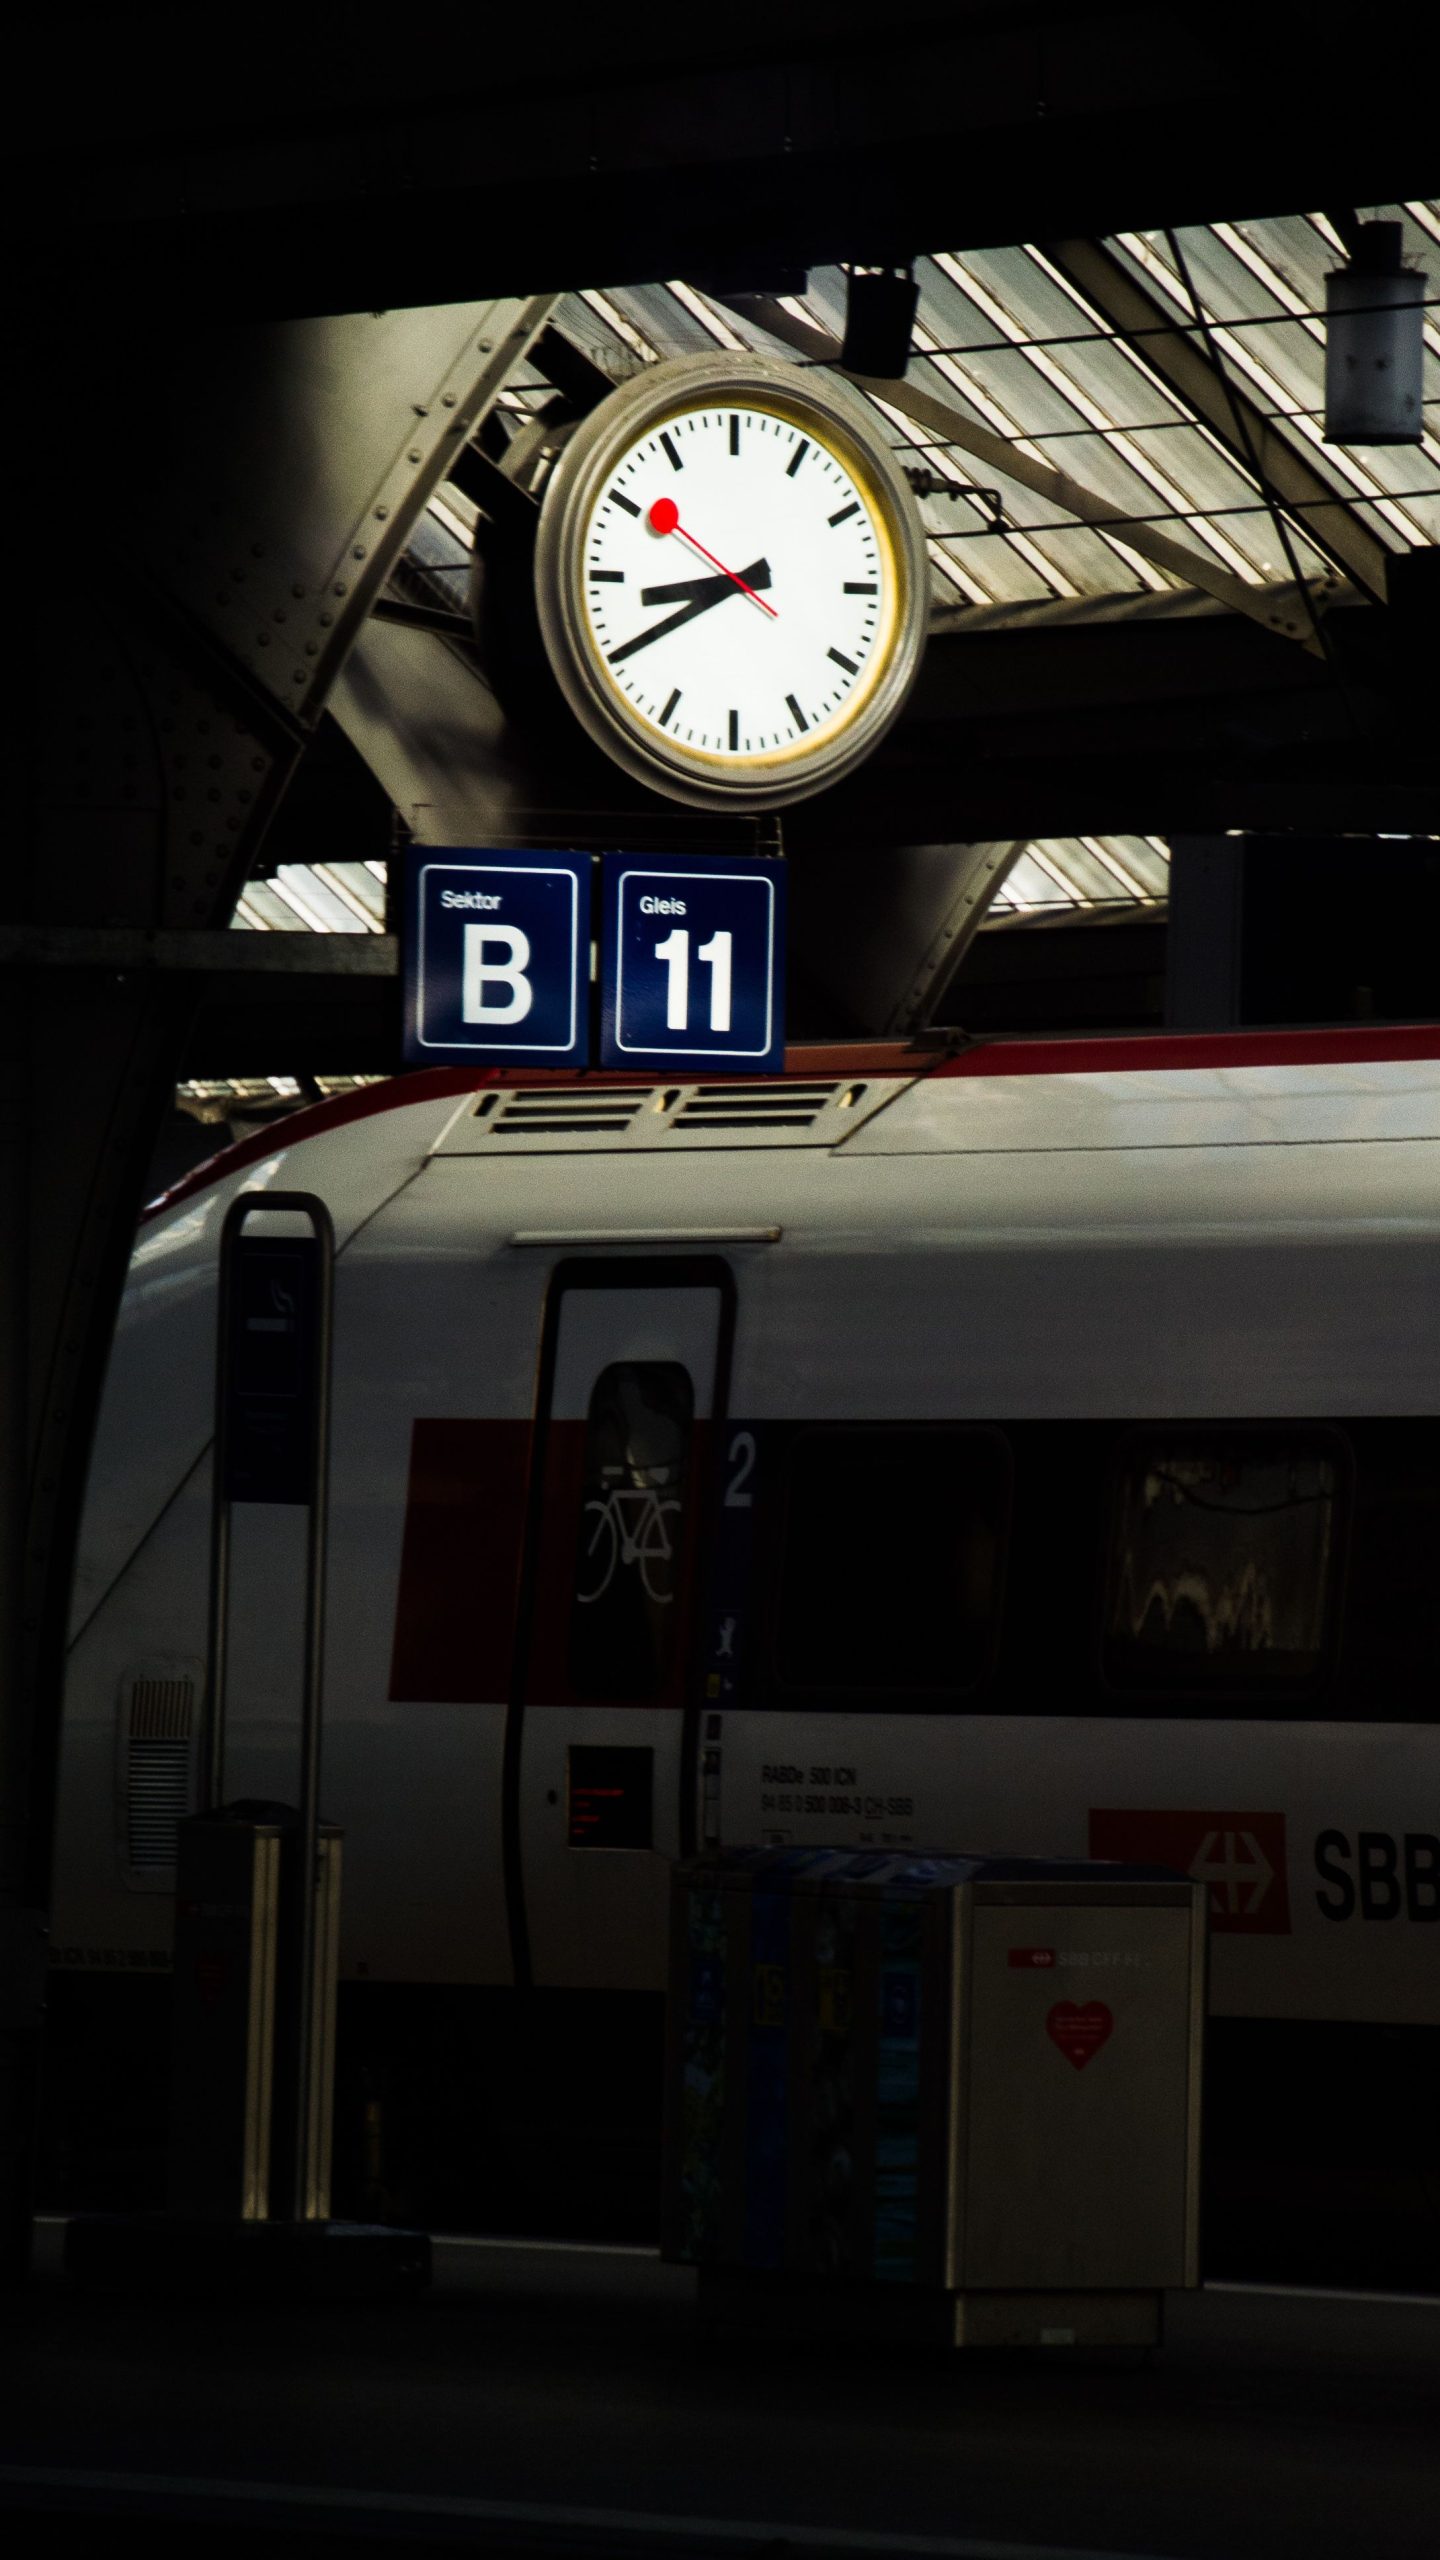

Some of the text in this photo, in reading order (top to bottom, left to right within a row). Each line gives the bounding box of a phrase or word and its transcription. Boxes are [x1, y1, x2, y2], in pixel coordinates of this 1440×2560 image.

[439, 888, 503, 911] Sektor
[638, 895, 689, 917] Gleis
[461, 922, 534, 1026] B
[653, 928, 734, 1033] 11
[723, 1430, 756, 1507] 2
[809, 1766, 832, 1786] 500
[833, 1766, 857, 1786] ICN
[1313, 1828, 1440, 1922] SBB
